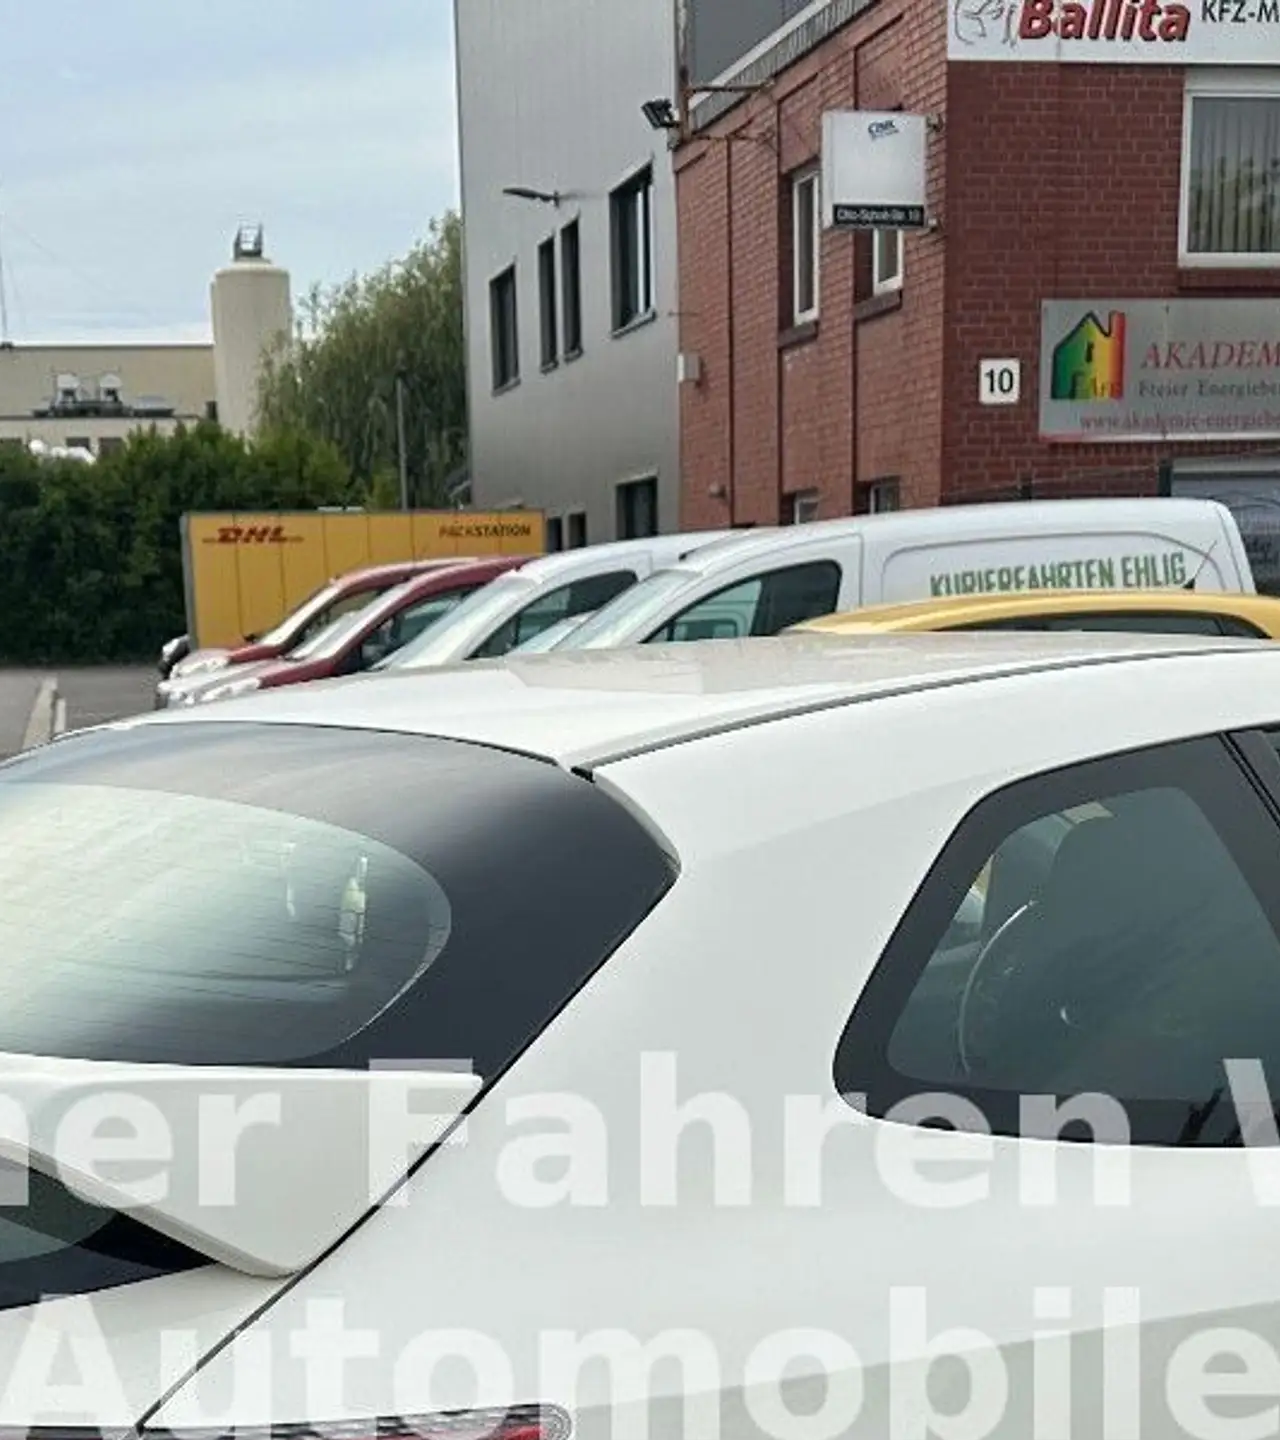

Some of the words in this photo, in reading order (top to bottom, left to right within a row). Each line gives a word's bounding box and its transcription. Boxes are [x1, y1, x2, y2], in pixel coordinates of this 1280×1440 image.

[1020, 0, 1191, 42] Ballita
[984, 367, 1014, 394] 10
[217, 526, 289, 544] DHL
[438, 523, 532, 538] PACKSTATION
[929, 557, 1115, 597] KURIERFAHRTEN
[1121, 551, 1187, 588] EHLIG
